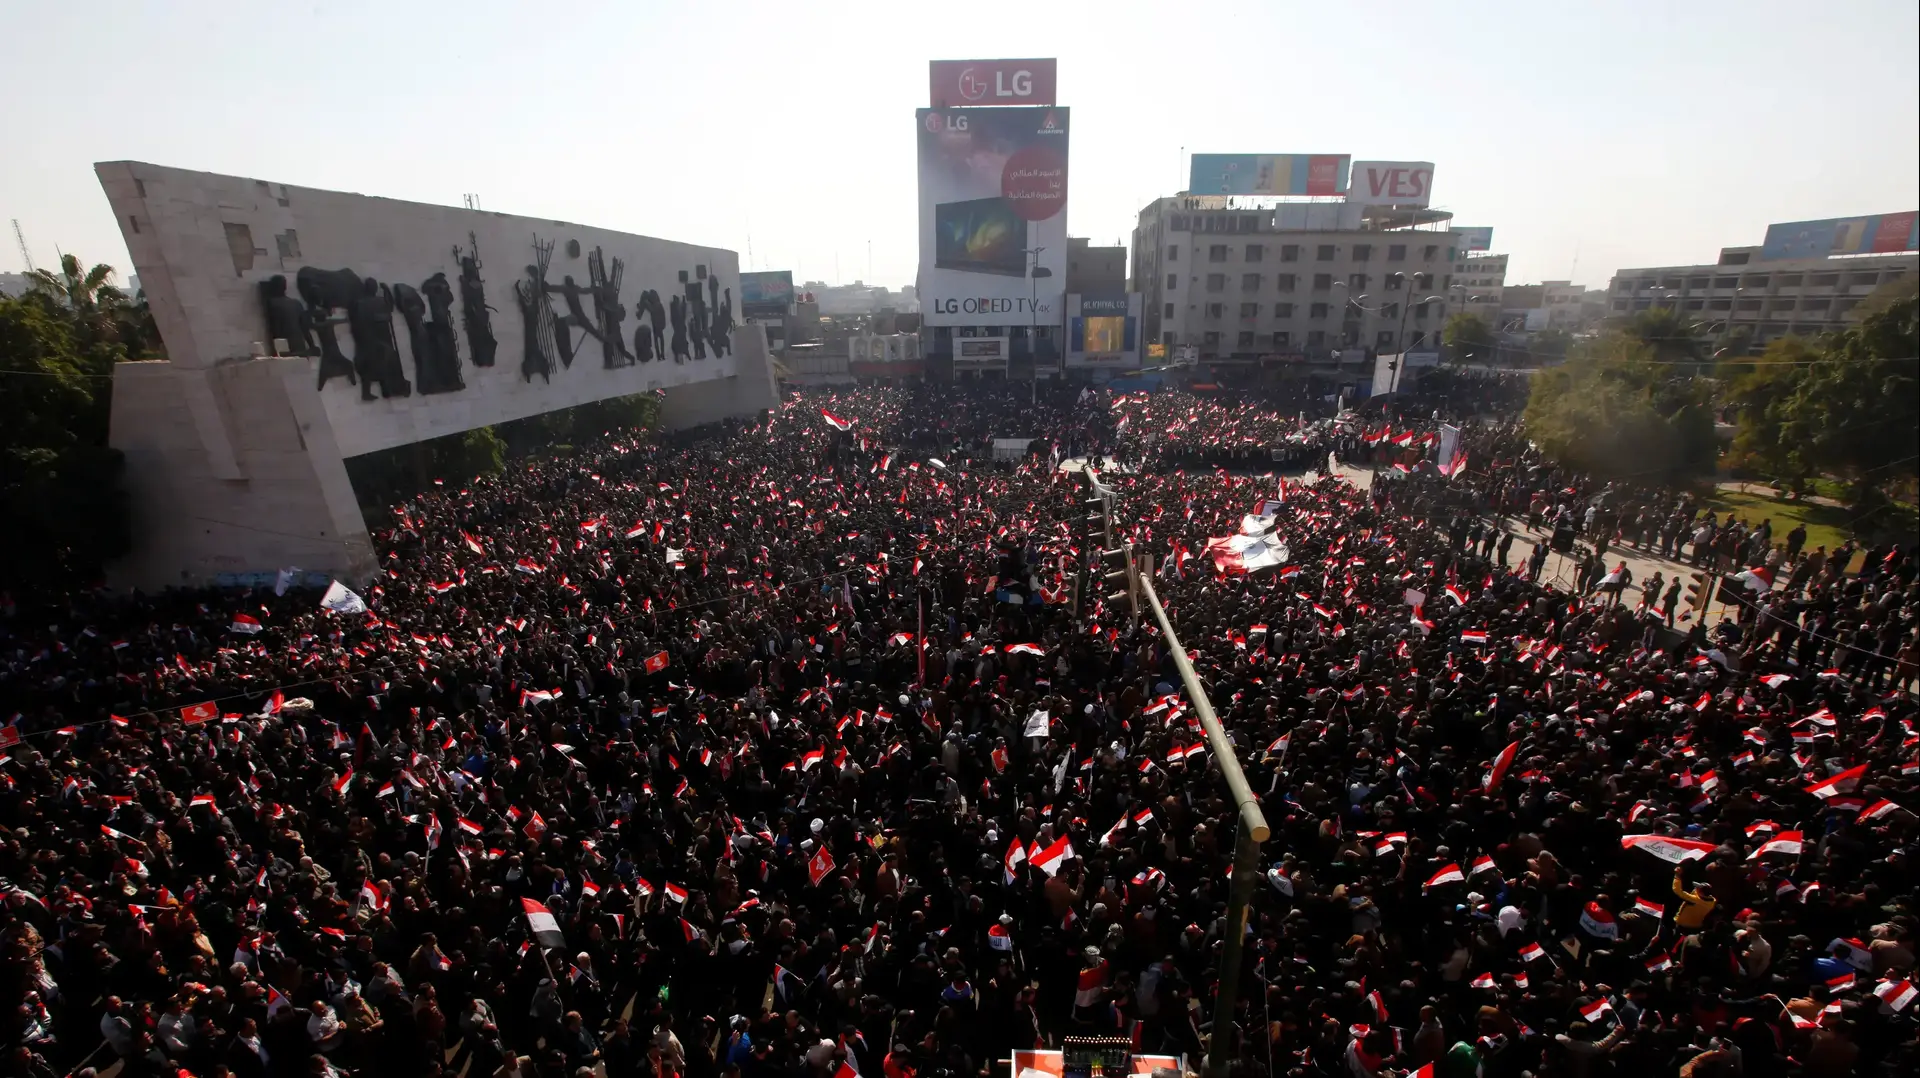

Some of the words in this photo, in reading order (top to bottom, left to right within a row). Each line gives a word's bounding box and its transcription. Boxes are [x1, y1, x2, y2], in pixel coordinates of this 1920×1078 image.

[996, 70, 1032, 96] LG
[947, 115, 968, 131] LG
[935, 298, 959, 314] LG
[963, 297, 1012, 314] OLED
[1015, 298, 1039, 313] TV
